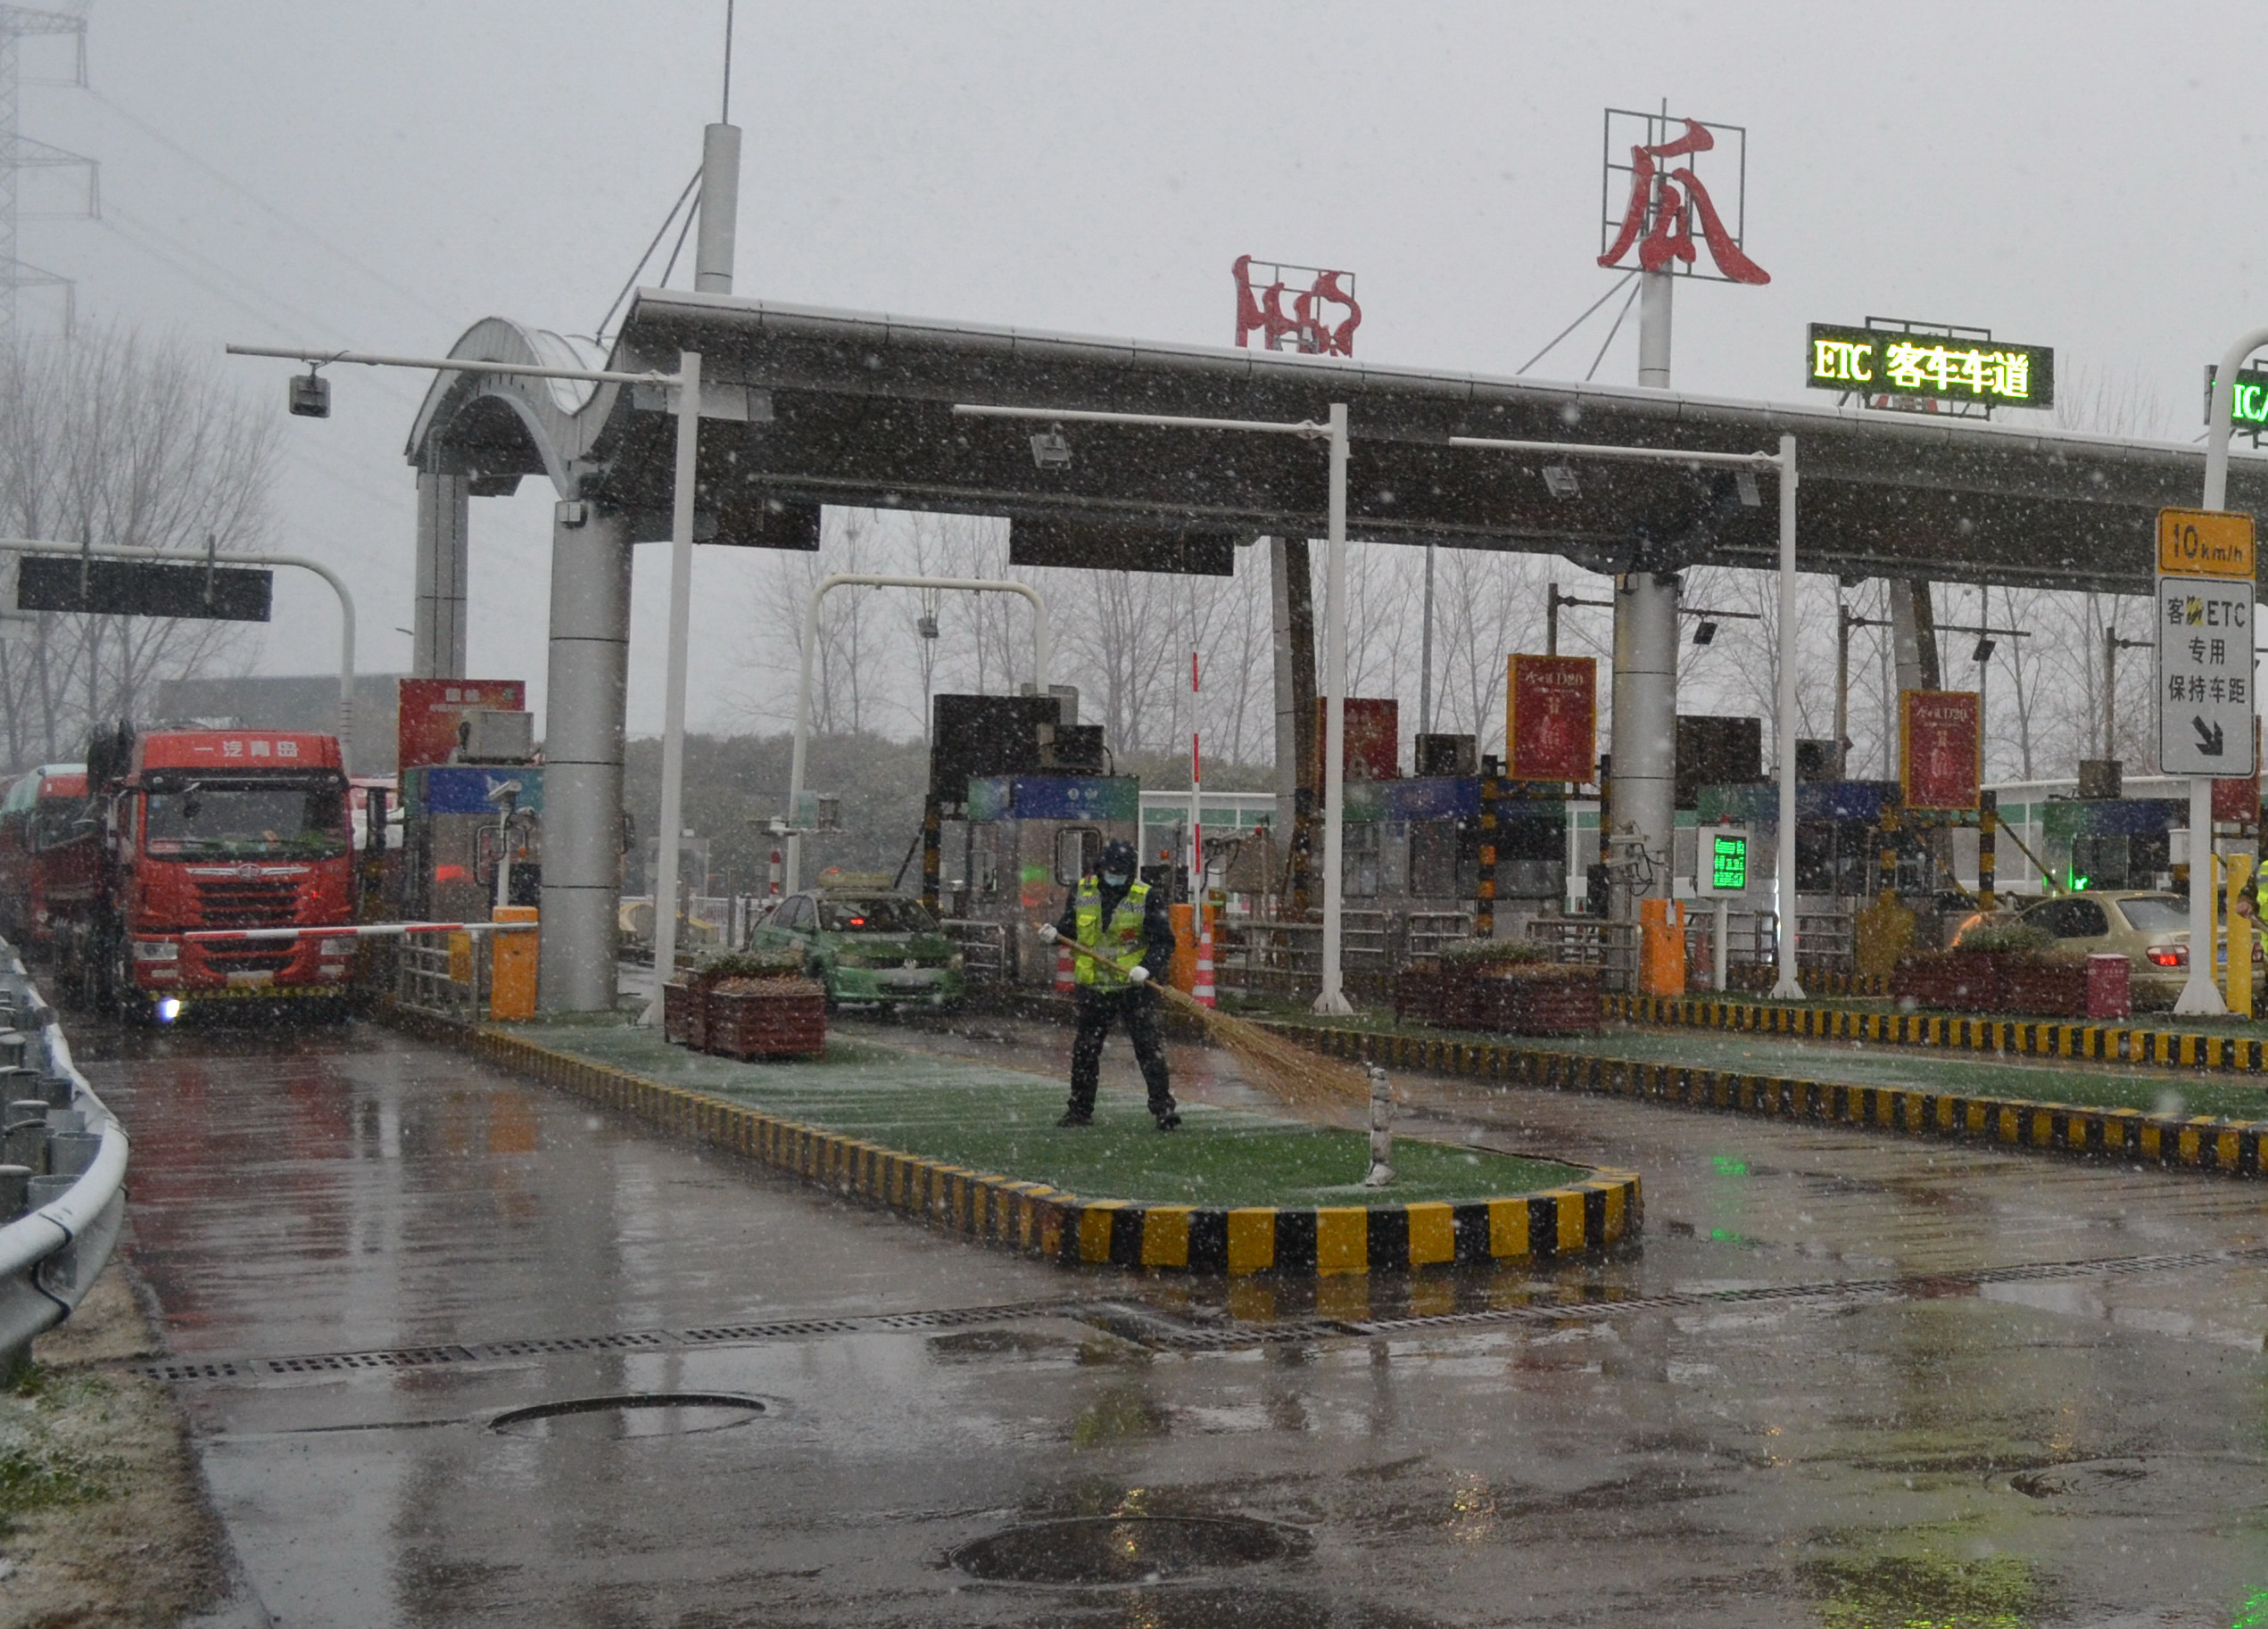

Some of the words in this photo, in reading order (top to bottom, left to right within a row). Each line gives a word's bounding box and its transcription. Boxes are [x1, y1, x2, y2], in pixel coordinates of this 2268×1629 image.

[1814, 340, 1872, 381] ETC
[1886, 343, 2029, 398] 客车车道
[2189, 636, 2225, 666] 专用
[2168, 674, 2246, 703] 保持车距
[194, 740, 299, 757] 一汽青岛
